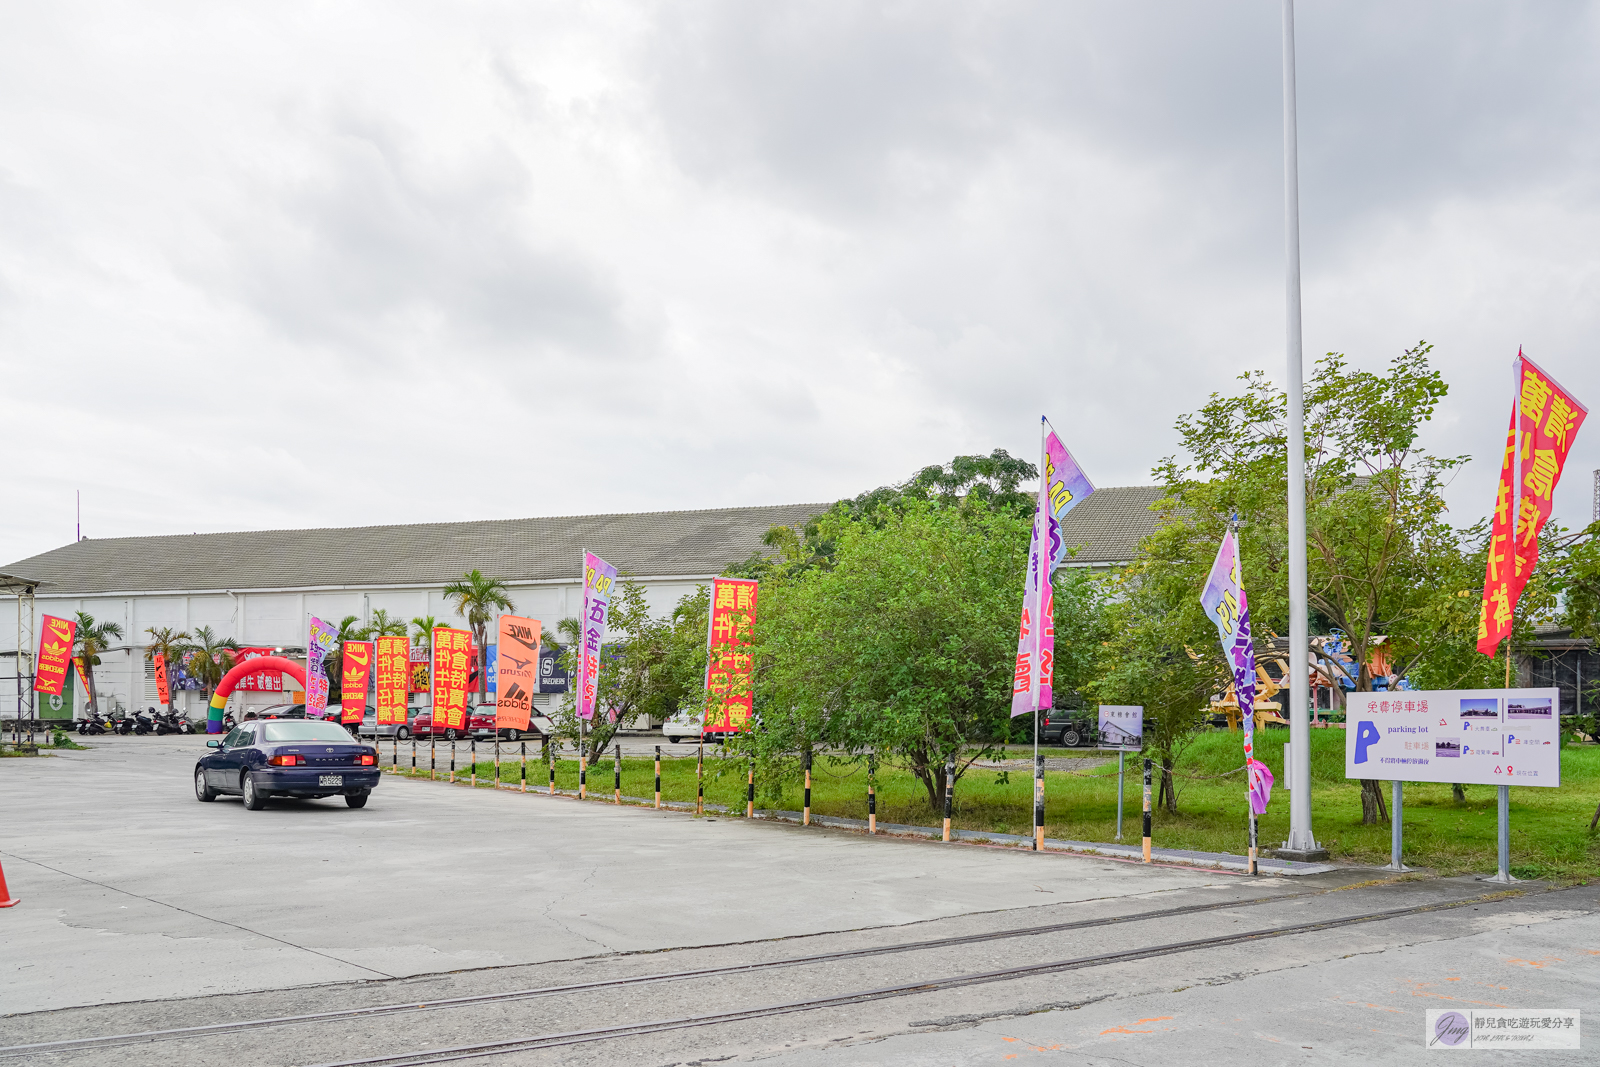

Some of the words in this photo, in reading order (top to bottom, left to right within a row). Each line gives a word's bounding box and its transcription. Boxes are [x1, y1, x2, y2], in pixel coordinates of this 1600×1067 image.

[1367, 700, 1429, 714] 免費停車場
[1387, 726, 1417, 734] parking
[1404, 741, 1430, 750] 駐車場
